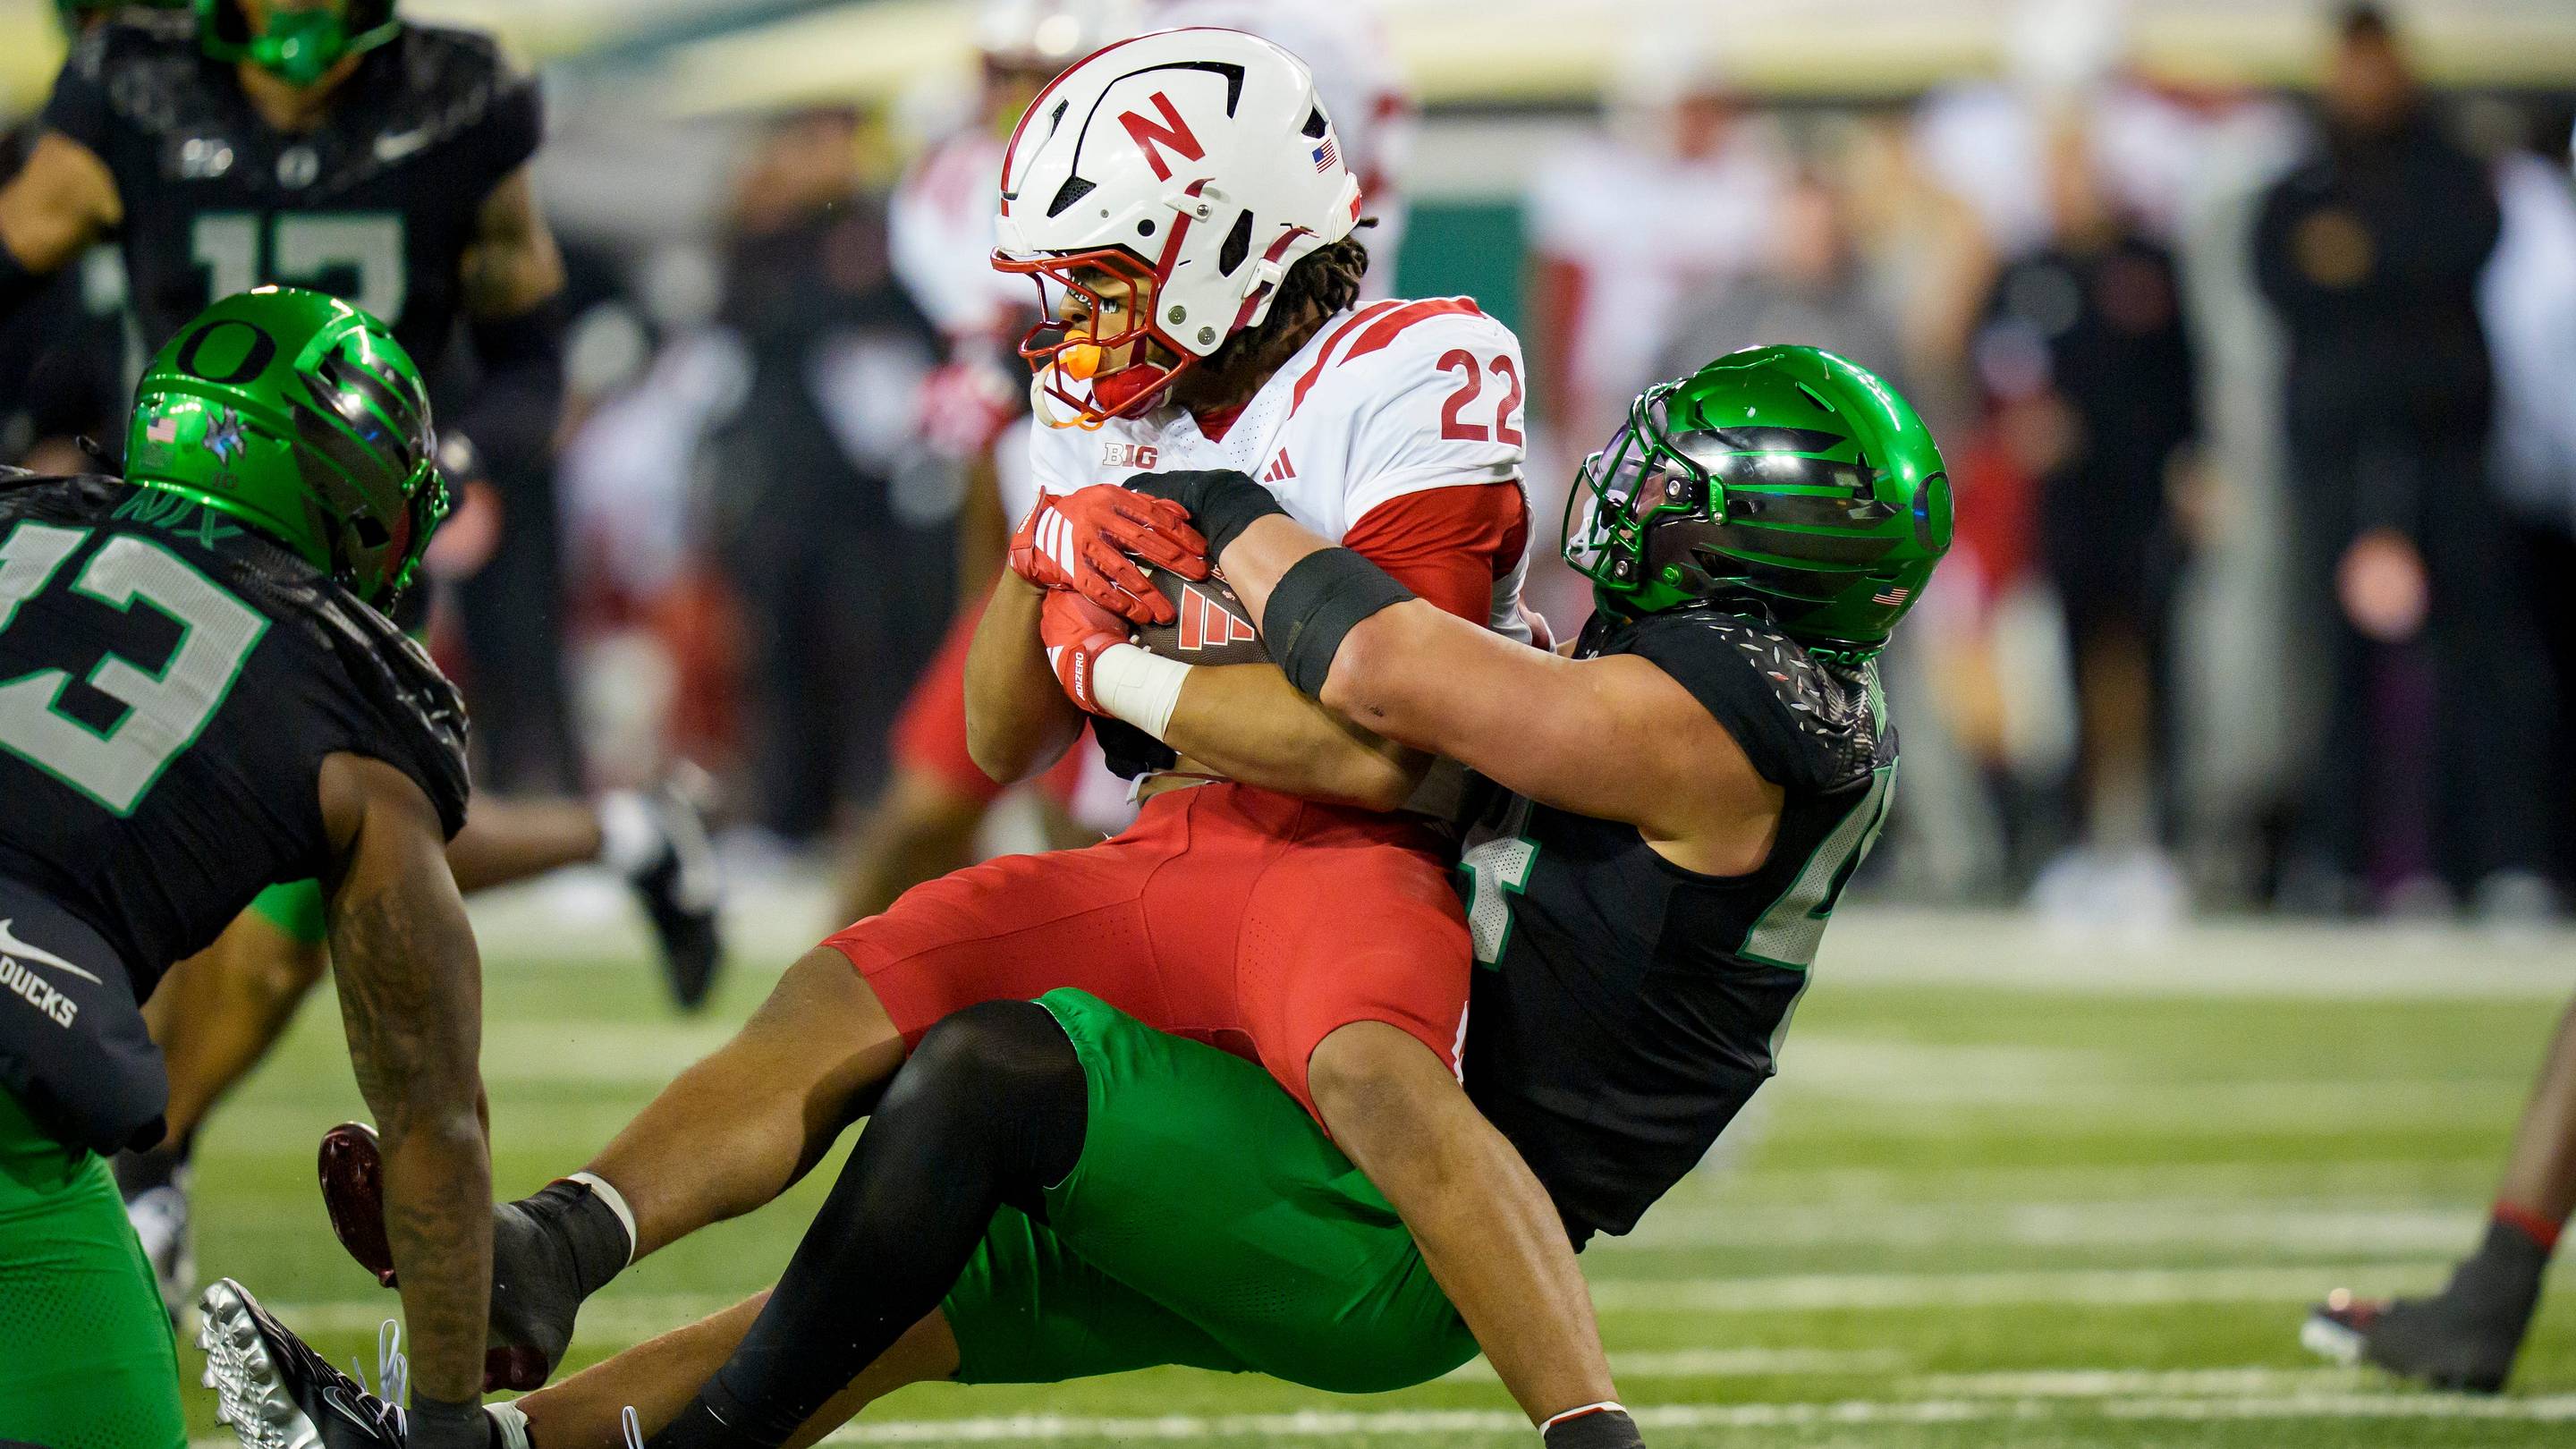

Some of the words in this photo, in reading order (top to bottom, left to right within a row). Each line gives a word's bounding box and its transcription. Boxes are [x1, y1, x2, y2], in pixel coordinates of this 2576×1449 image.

[1117, 91, 1205, 182] N
[176, 319, 276, 384] O
[1436, 349, 1522, 447] 22
[1075, 652, 1086, 701] ADIZERO
[0, 955, 79, 1029] DUCKS
